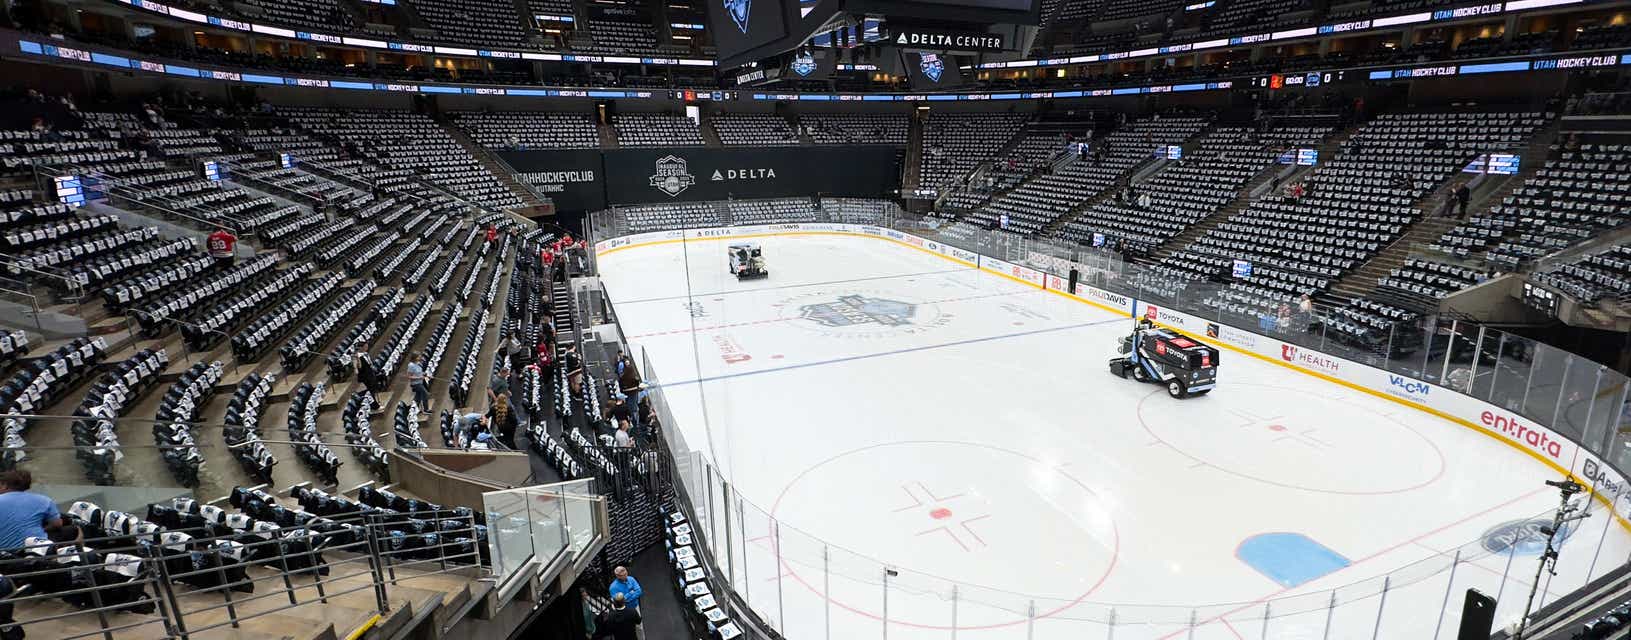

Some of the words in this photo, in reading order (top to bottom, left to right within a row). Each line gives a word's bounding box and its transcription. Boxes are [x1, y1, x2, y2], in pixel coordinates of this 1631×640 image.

[1434, 9, 1453, 19] UTAH
[1453, 6, 1482, 17] HOCKEY
[1481, 3, 1502, 14] CLUB
[1333, 22, 1355, 32] HOCKEY
[1354, 20, 1371, 29] CLUB
[388, 42, 402, 50] UTAH
[911, 33, 952, 46] DELTA
[955, 36, 1000, 48] CENTER
[1534, 60, 1557, 70] UTAH
[1556, 57, 1592, 68] HOCKEY
[1591, 55, 1617, 66] CLUB
[1324, 73, 1332, 83] 0
[1394, 70, 1412, 78] UTAH
[1411, 68, 1438, 77] HOCKEY
[1437, 66, 1456, 75] CLUB
[1260, 78, 1267, 87] 0
[727, 168, 776, 180] DELTA
[1158, 311, 1184, 326] TOYOTA
[1165, 346, 1188, 362] TOYOTA
[1300, 352, 1339, 371] HEALTH
[1481, 410, 1561, 458] entrata
